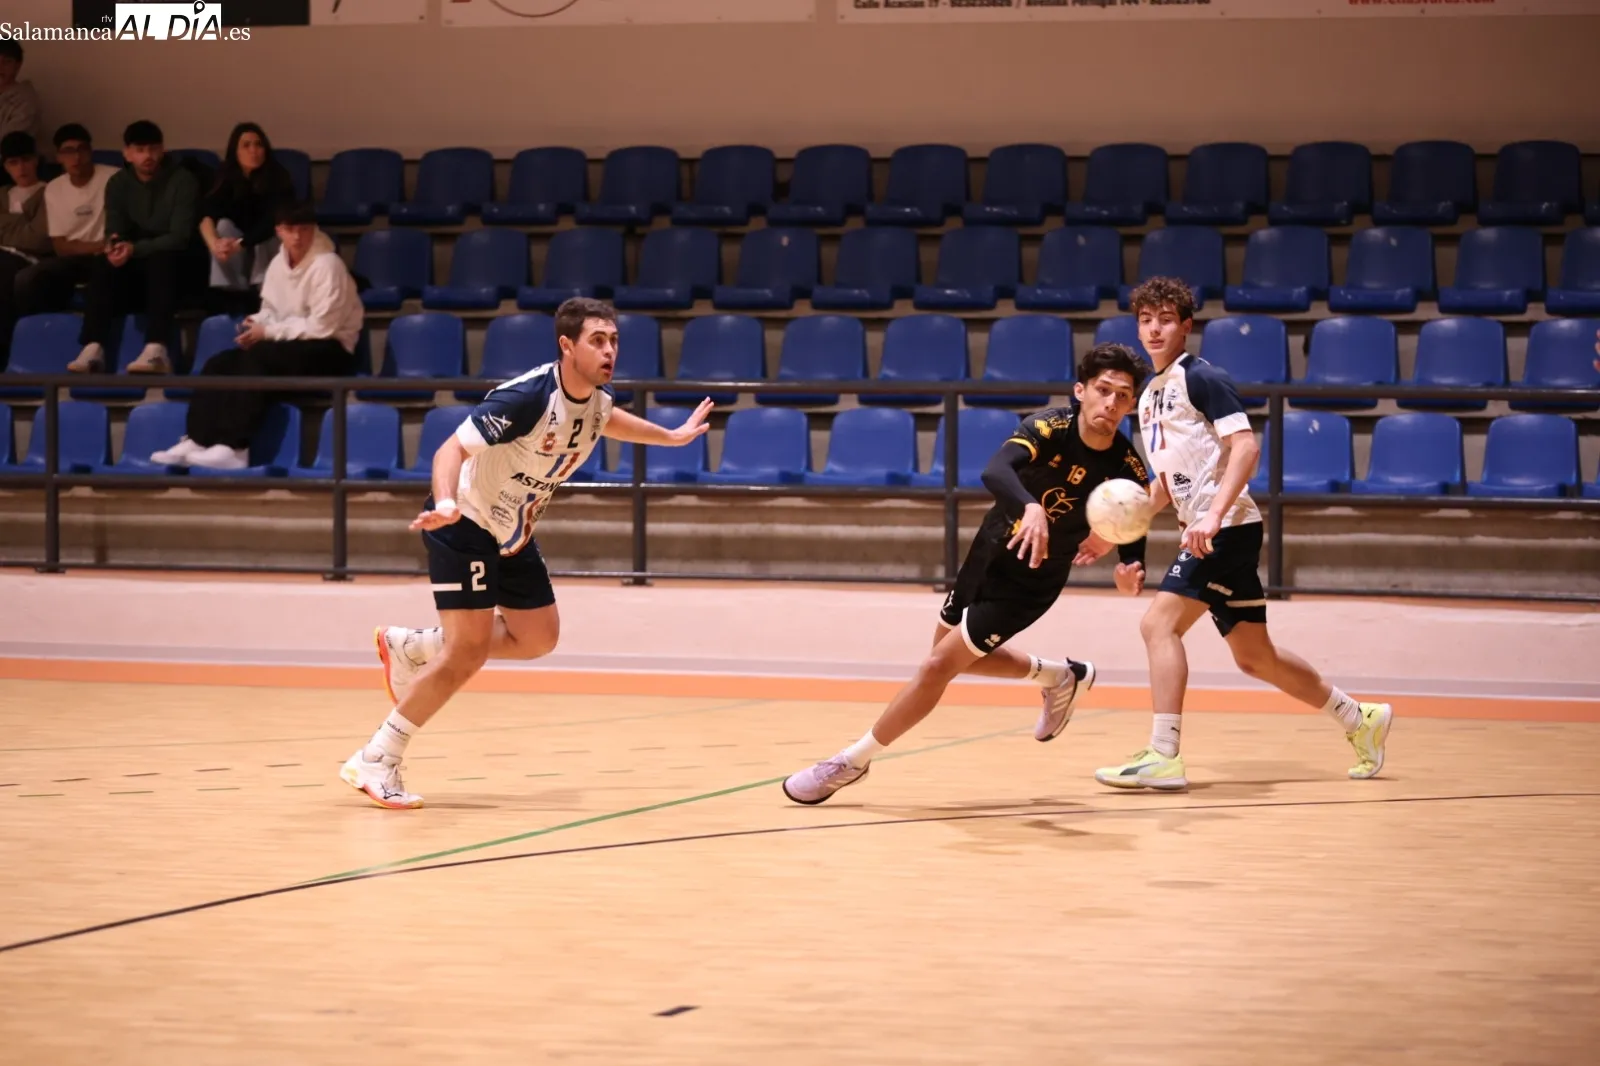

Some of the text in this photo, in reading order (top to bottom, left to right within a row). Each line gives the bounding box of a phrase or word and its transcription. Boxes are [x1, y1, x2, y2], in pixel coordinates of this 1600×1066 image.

[567, 418, 584, 449] 2
[1066, 464, 1087, 485] 18
[470, 560, 488, 592] 2
